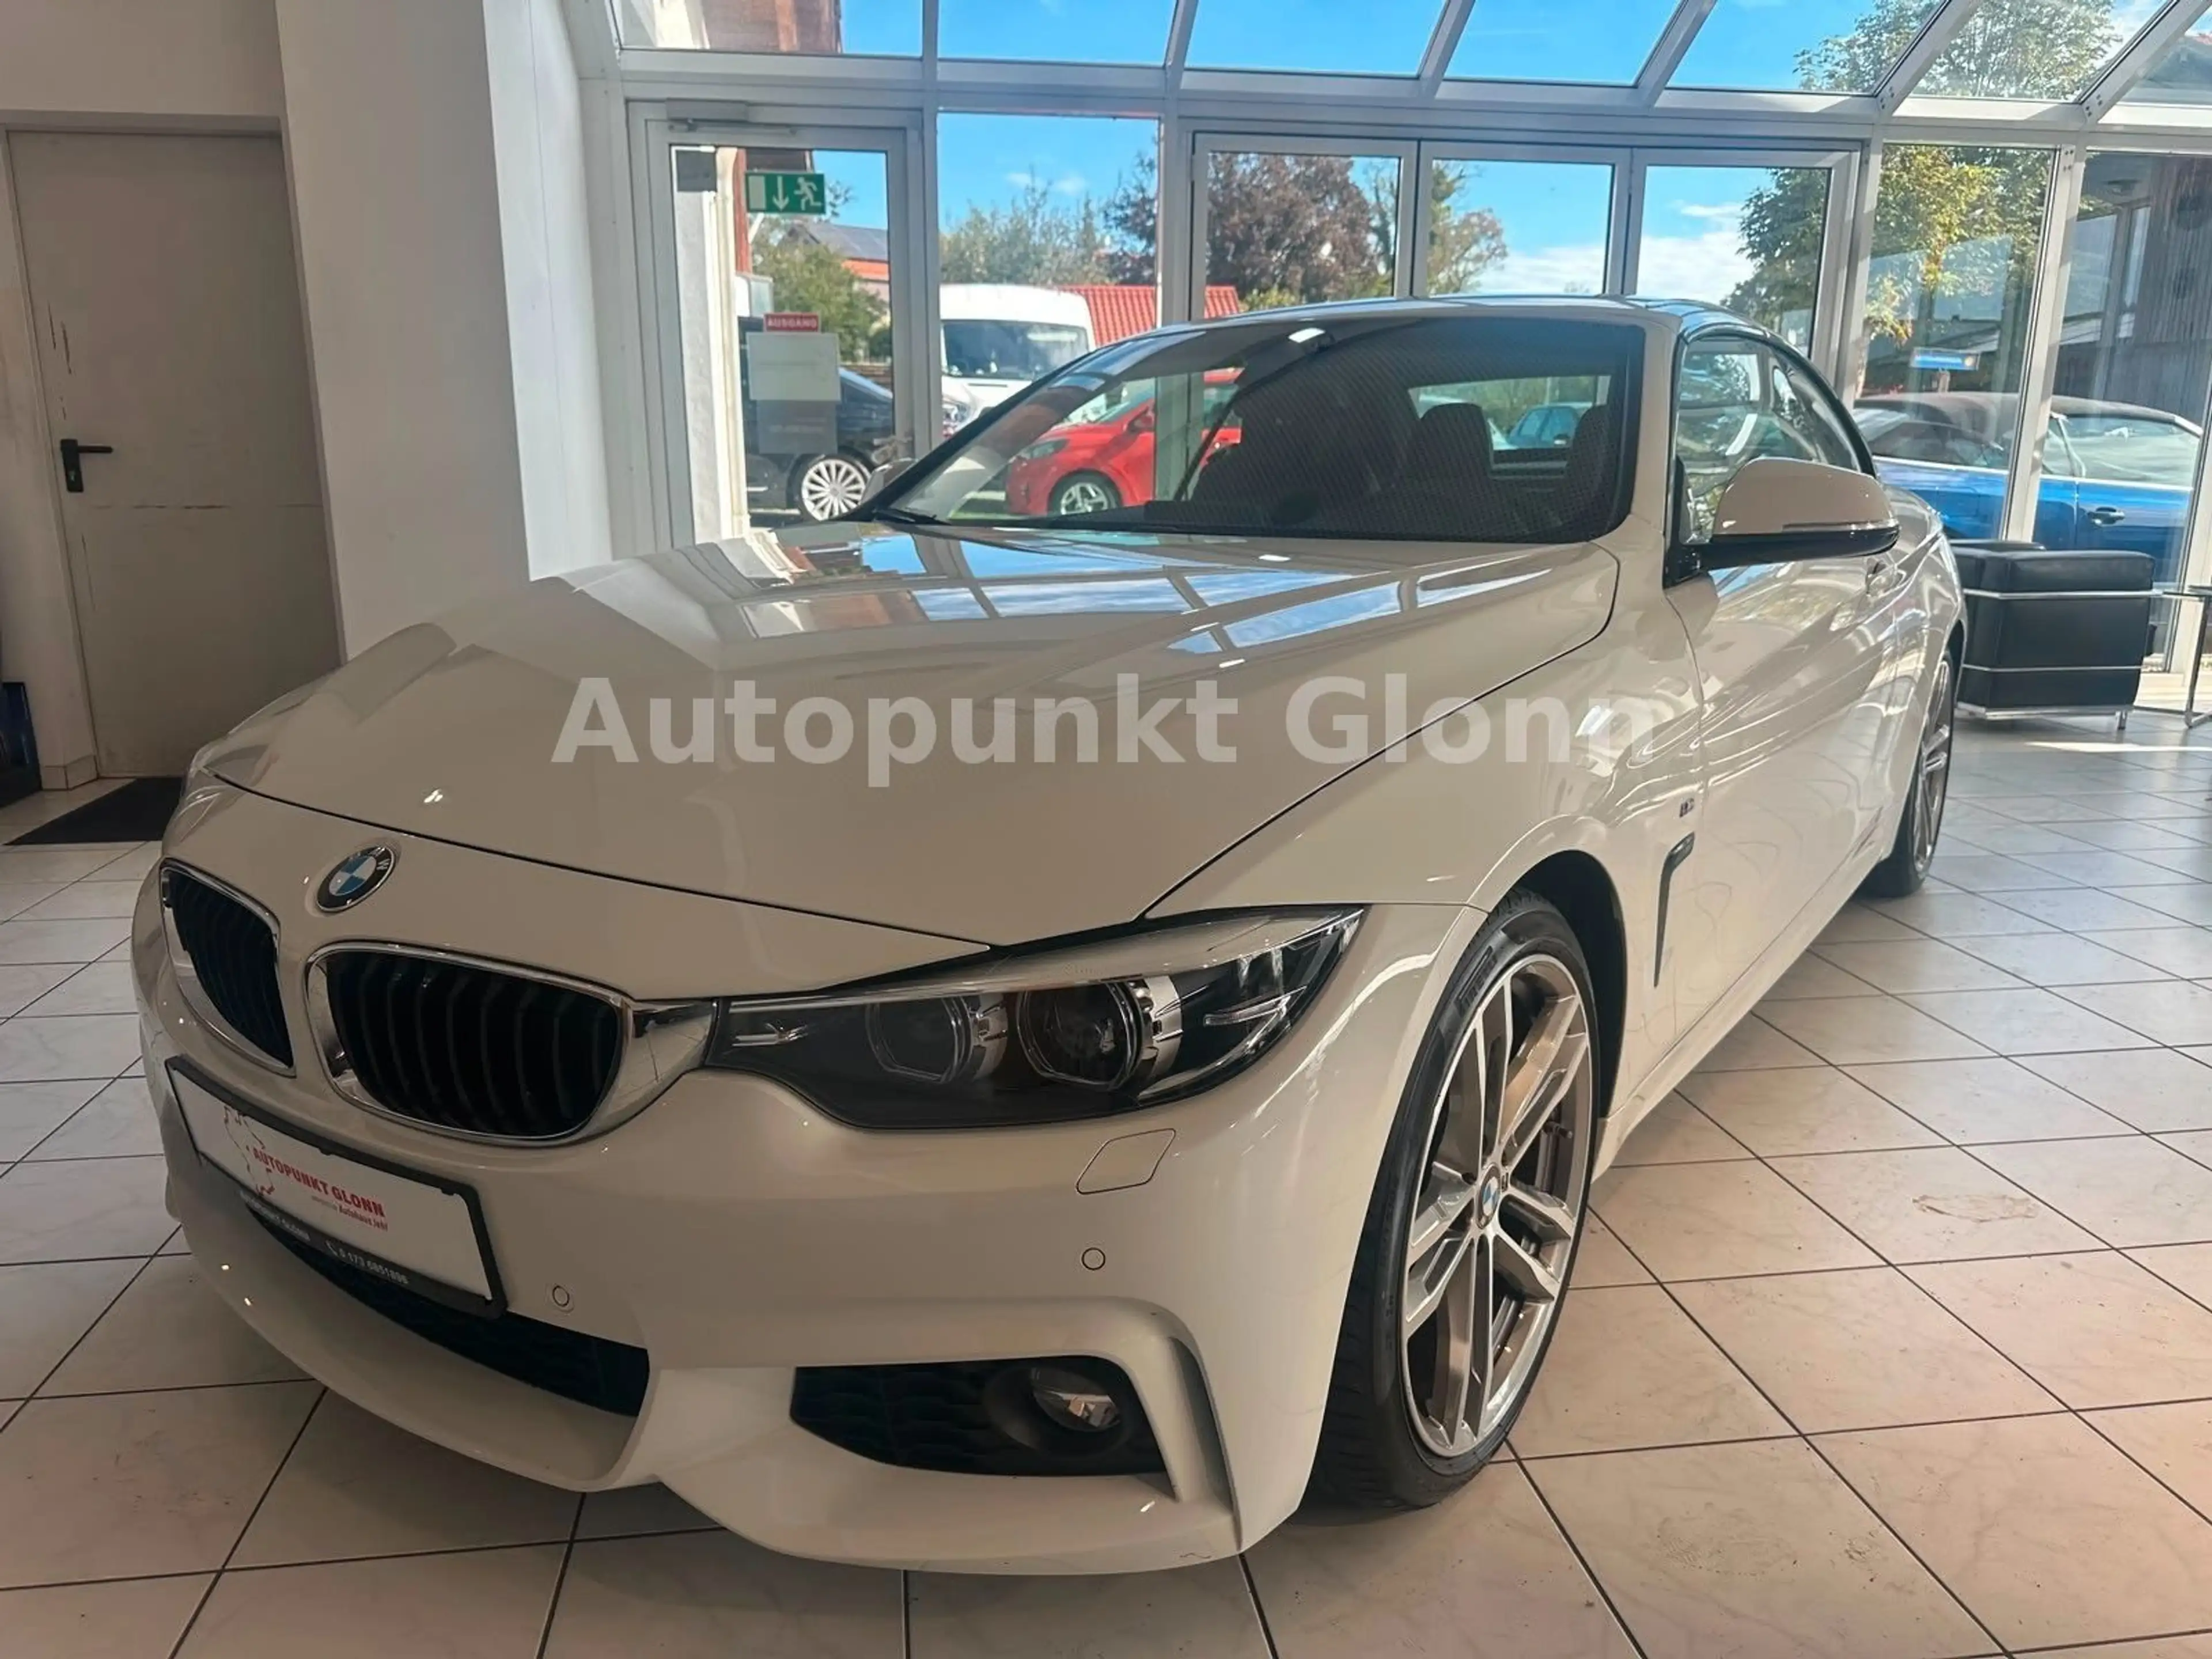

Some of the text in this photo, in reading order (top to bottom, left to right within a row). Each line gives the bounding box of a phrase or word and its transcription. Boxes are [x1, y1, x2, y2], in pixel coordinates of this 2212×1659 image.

[768, 317, 817, 328] AUSGANG
[253, 1146, 329, 1195] AUTOPUNKT
[332, 1185, 385, 1217] GLONN
